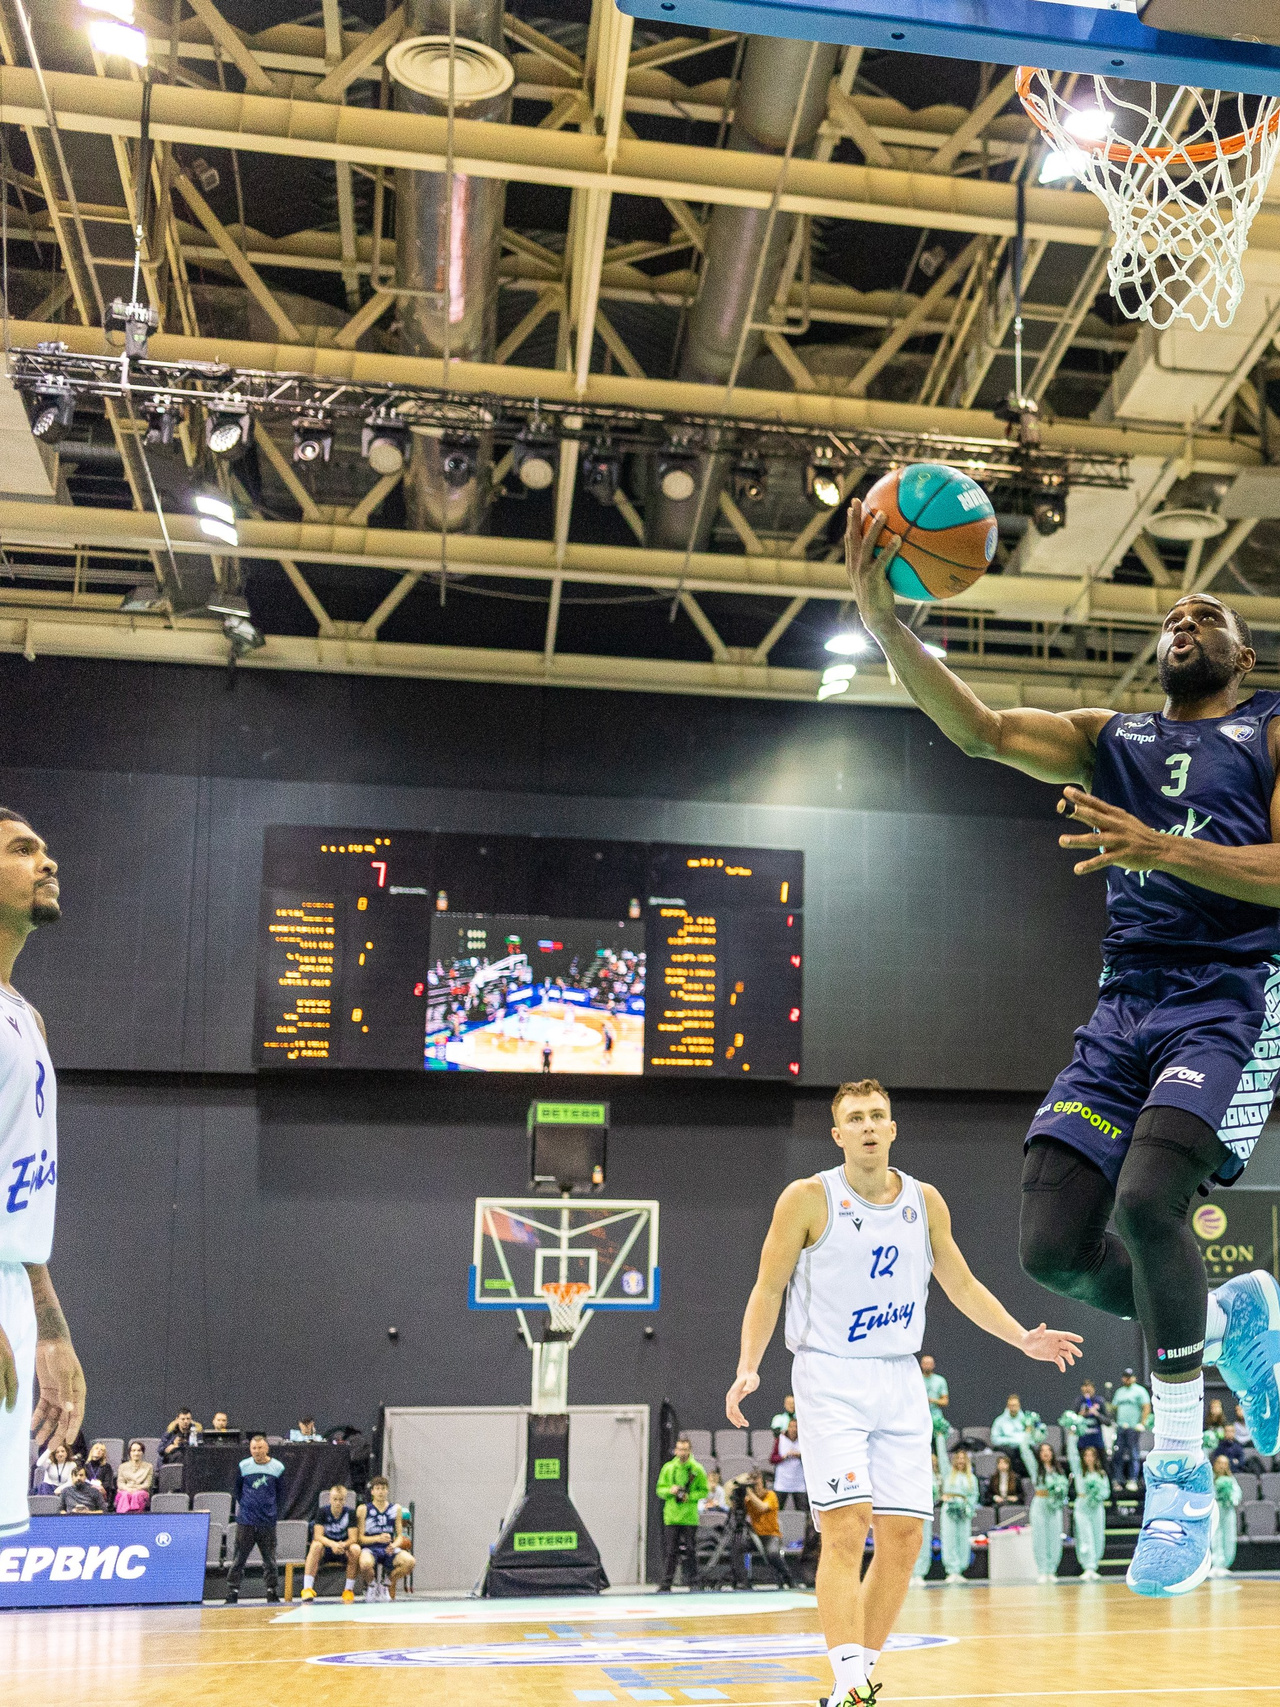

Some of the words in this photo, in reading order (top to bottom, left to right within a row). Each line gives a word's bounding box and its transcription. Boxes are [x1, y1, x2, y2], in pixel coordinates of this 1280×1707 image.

[1115, 727, 1156, 745] Kempa
[1160, 753, 1193, 797] 3
[371, 861, 387, 887] 7
[869, 1245, 899, 1279] 12
[1201, 1244, 1254, 1262] CON
[847, 1301, 916, 1343] Enisey
